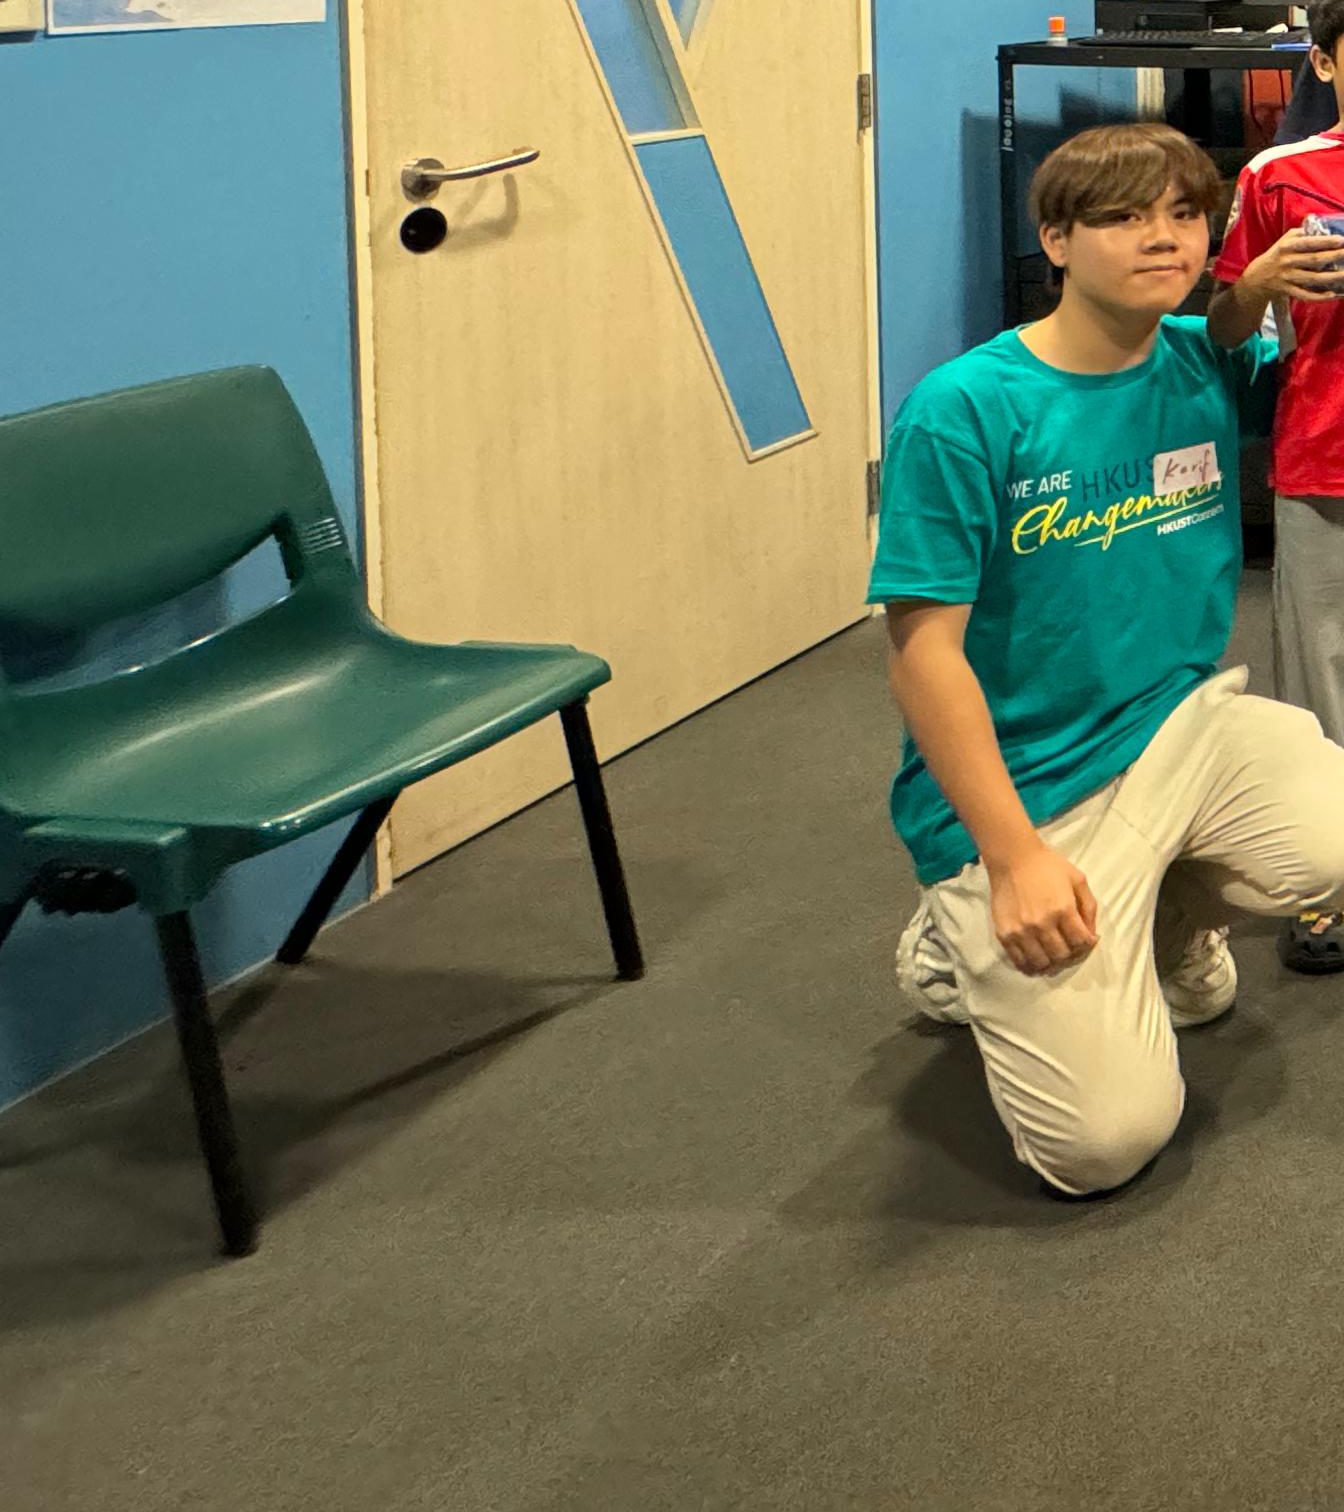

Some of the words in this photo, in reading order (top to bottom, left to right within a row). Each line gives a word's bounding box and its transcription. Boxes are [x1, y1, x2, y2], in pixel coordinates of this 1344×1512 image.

[1007, 479, 1035, 500] WE
[1037, 470, 1073, 494] ARE
[1081, 456, 1154, 502] HKUS
